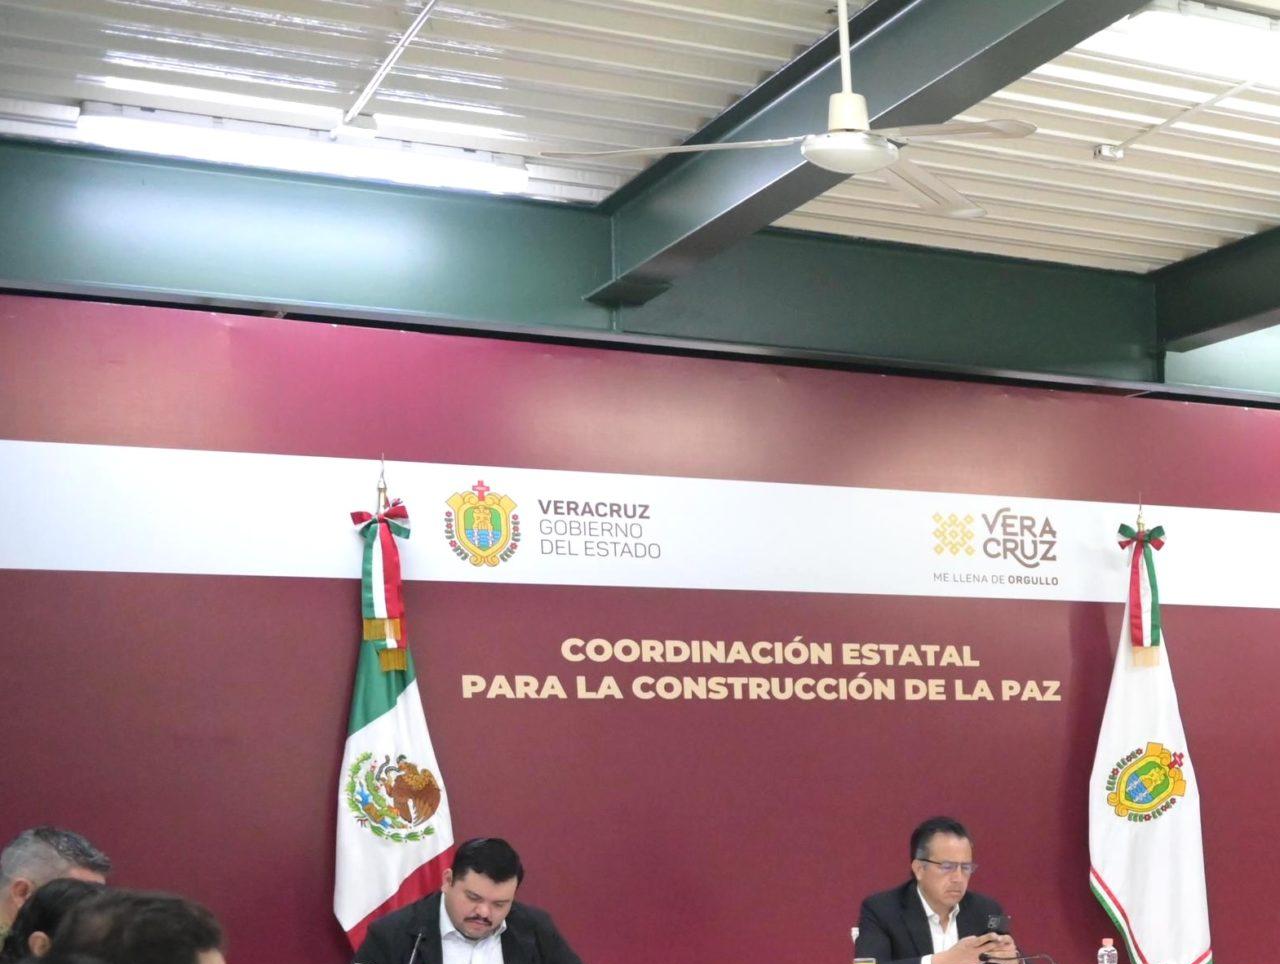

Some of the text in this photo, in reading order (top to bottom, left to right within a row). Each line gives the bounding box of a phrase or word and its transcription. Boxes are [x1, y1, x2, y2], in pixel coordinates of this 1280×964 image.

[538, 499, 651, 520] VERACRUZ
[540, 519, 643, 539] GOBIERNO
[981, 507, 1057, 539] VERA
[540, 539, 661, 559] DEL ESTADO
[982, 537, 1057, 568] CRUZ
[933, 572, 1059, 586] ME LLENA DE ORGULLO
[560, 636, 980, 667] COORDINACIÓN ESTATAL
[461, 672, 1062, 701] PARA LA CONSTRUCCIÓN DE LA PAZ
